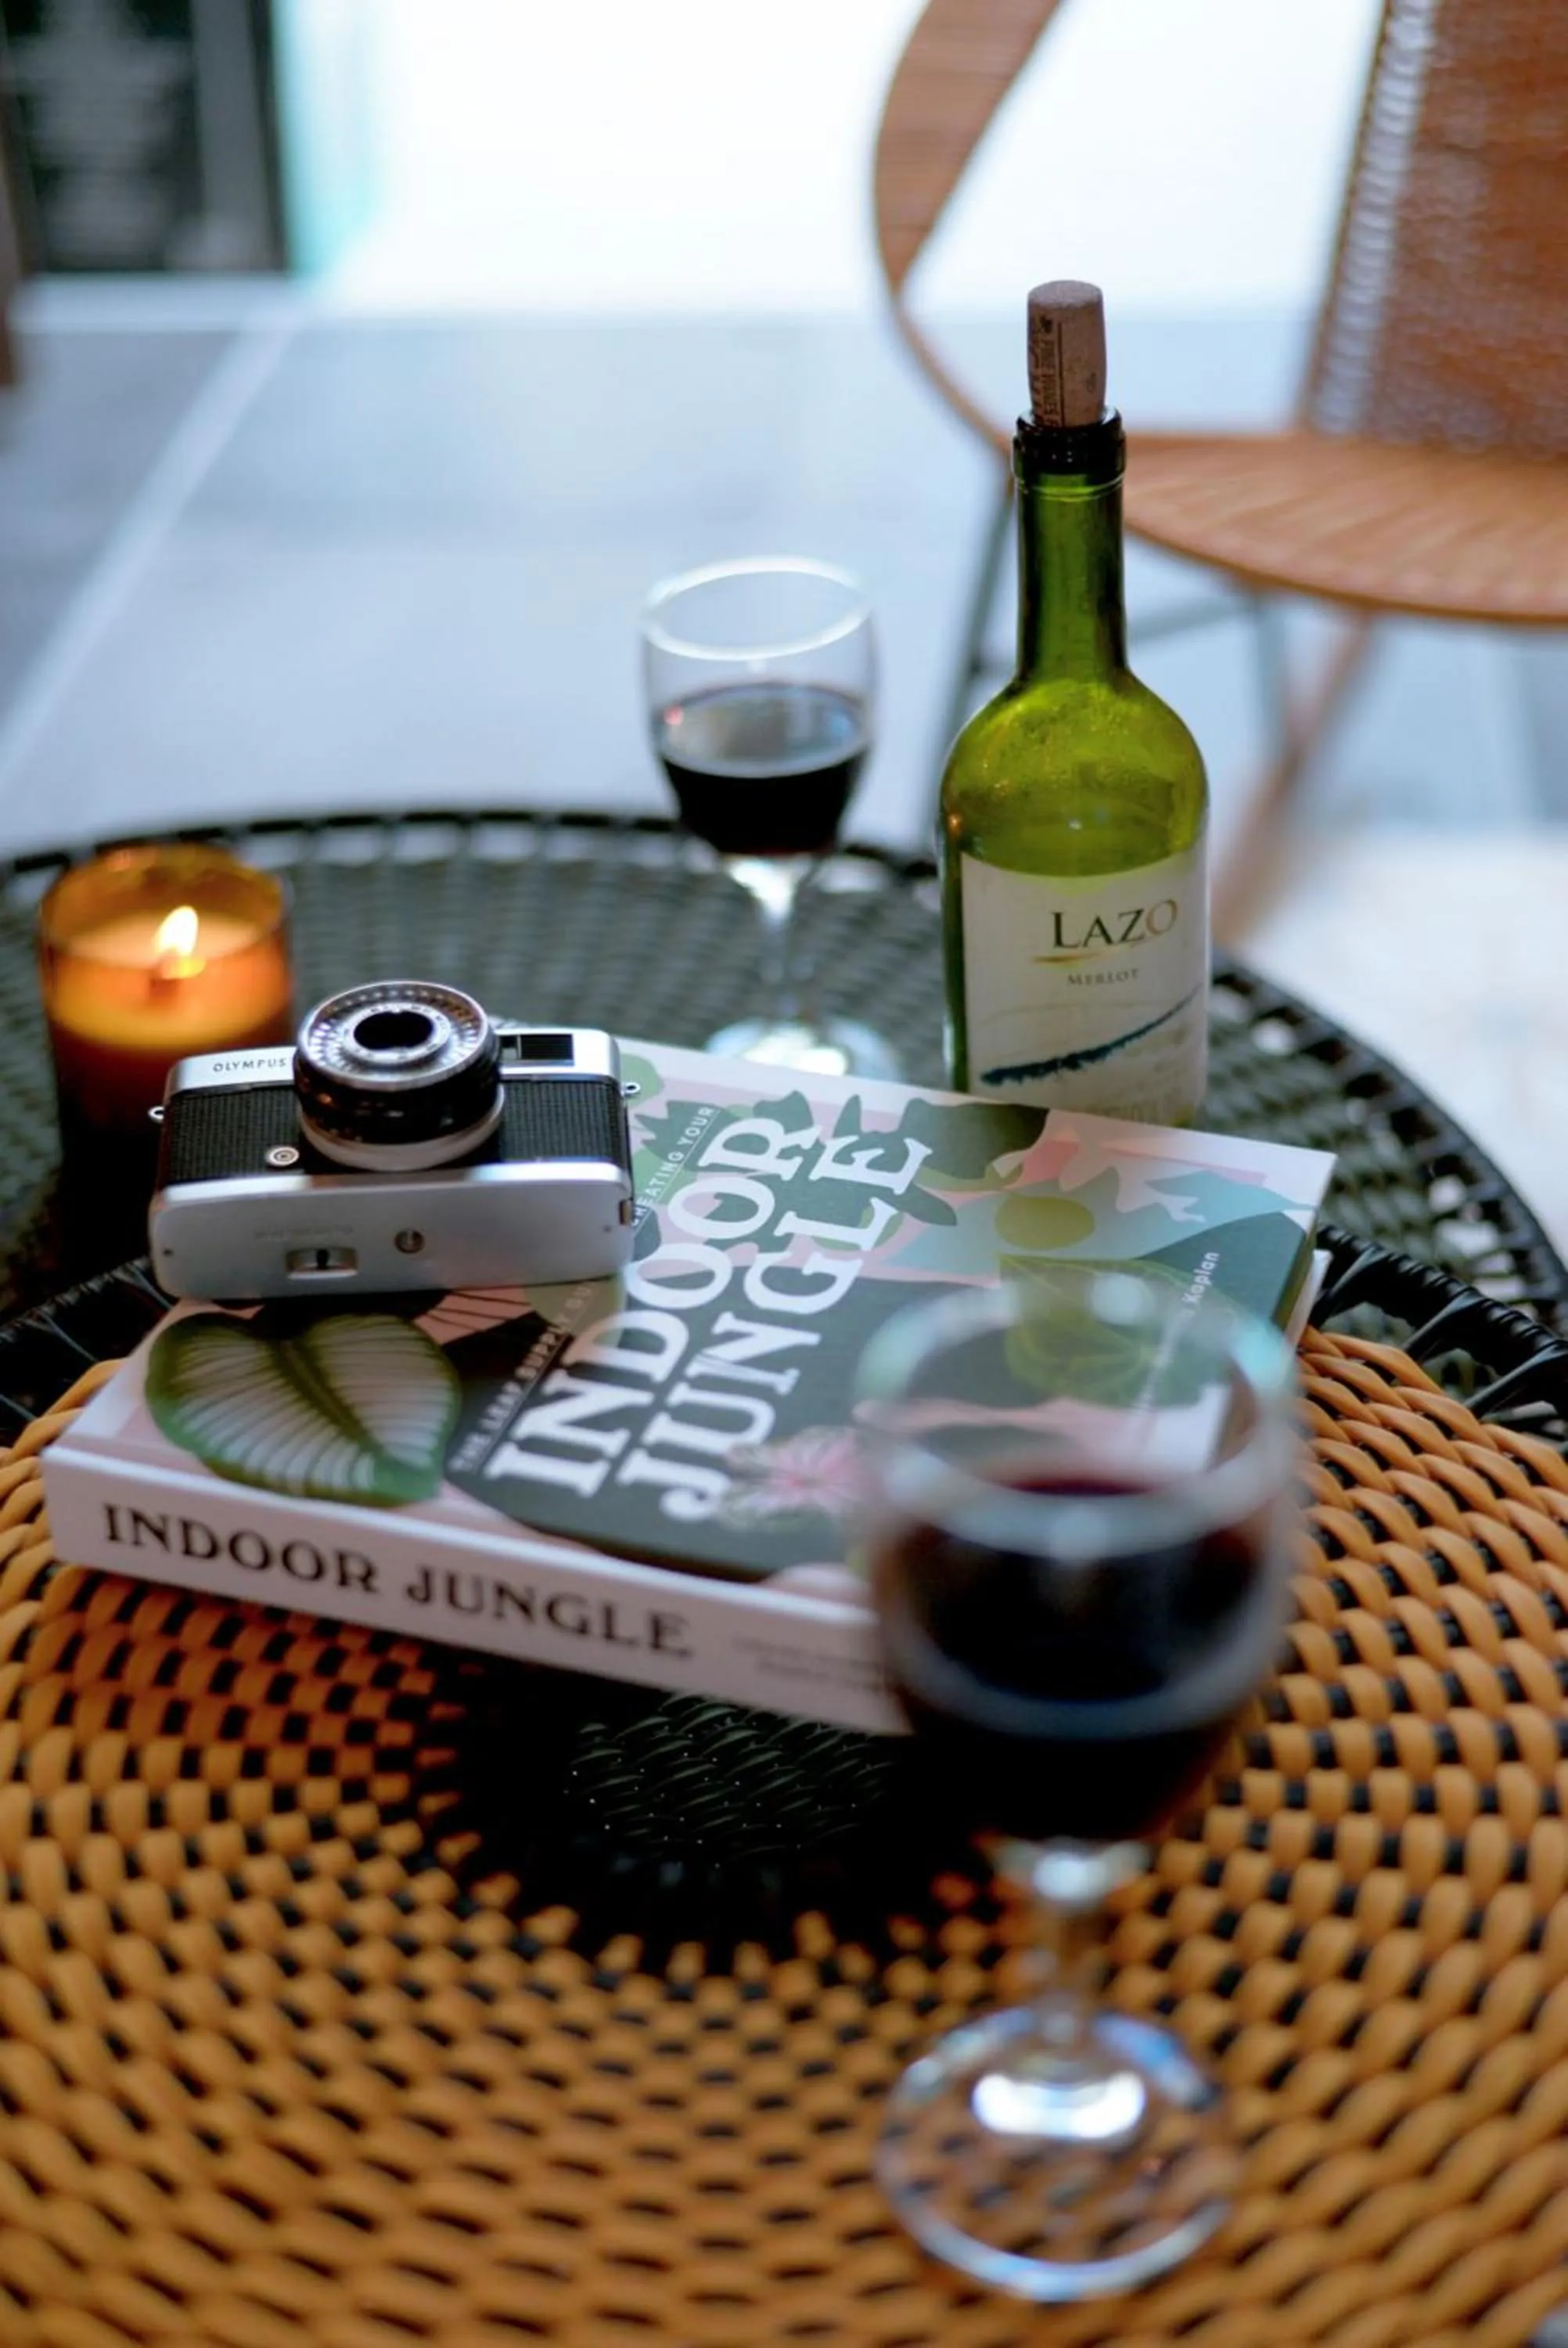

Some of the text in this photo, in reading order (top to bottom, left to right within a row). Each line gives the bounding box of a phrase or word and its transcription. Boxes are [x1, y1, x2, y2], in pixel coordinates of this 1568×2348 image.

[1051, 899, 1178, 949] LAZO
[1067, 967, 1139, 987] MERLOT
[212, 1057, 287, 1072] OLYMPUS
[676, 1106, 717, 1146] YOUR
[1180, 1251, 1221, 1305] Kaplan
[483, 1117, 822, 1498] INDOOR
[617, 1132, 933, 1521] JUNGLE
[448, 1432, 492, 1472] THE
[102, 1502, 693, 1660] INDOOR JUNGLE
